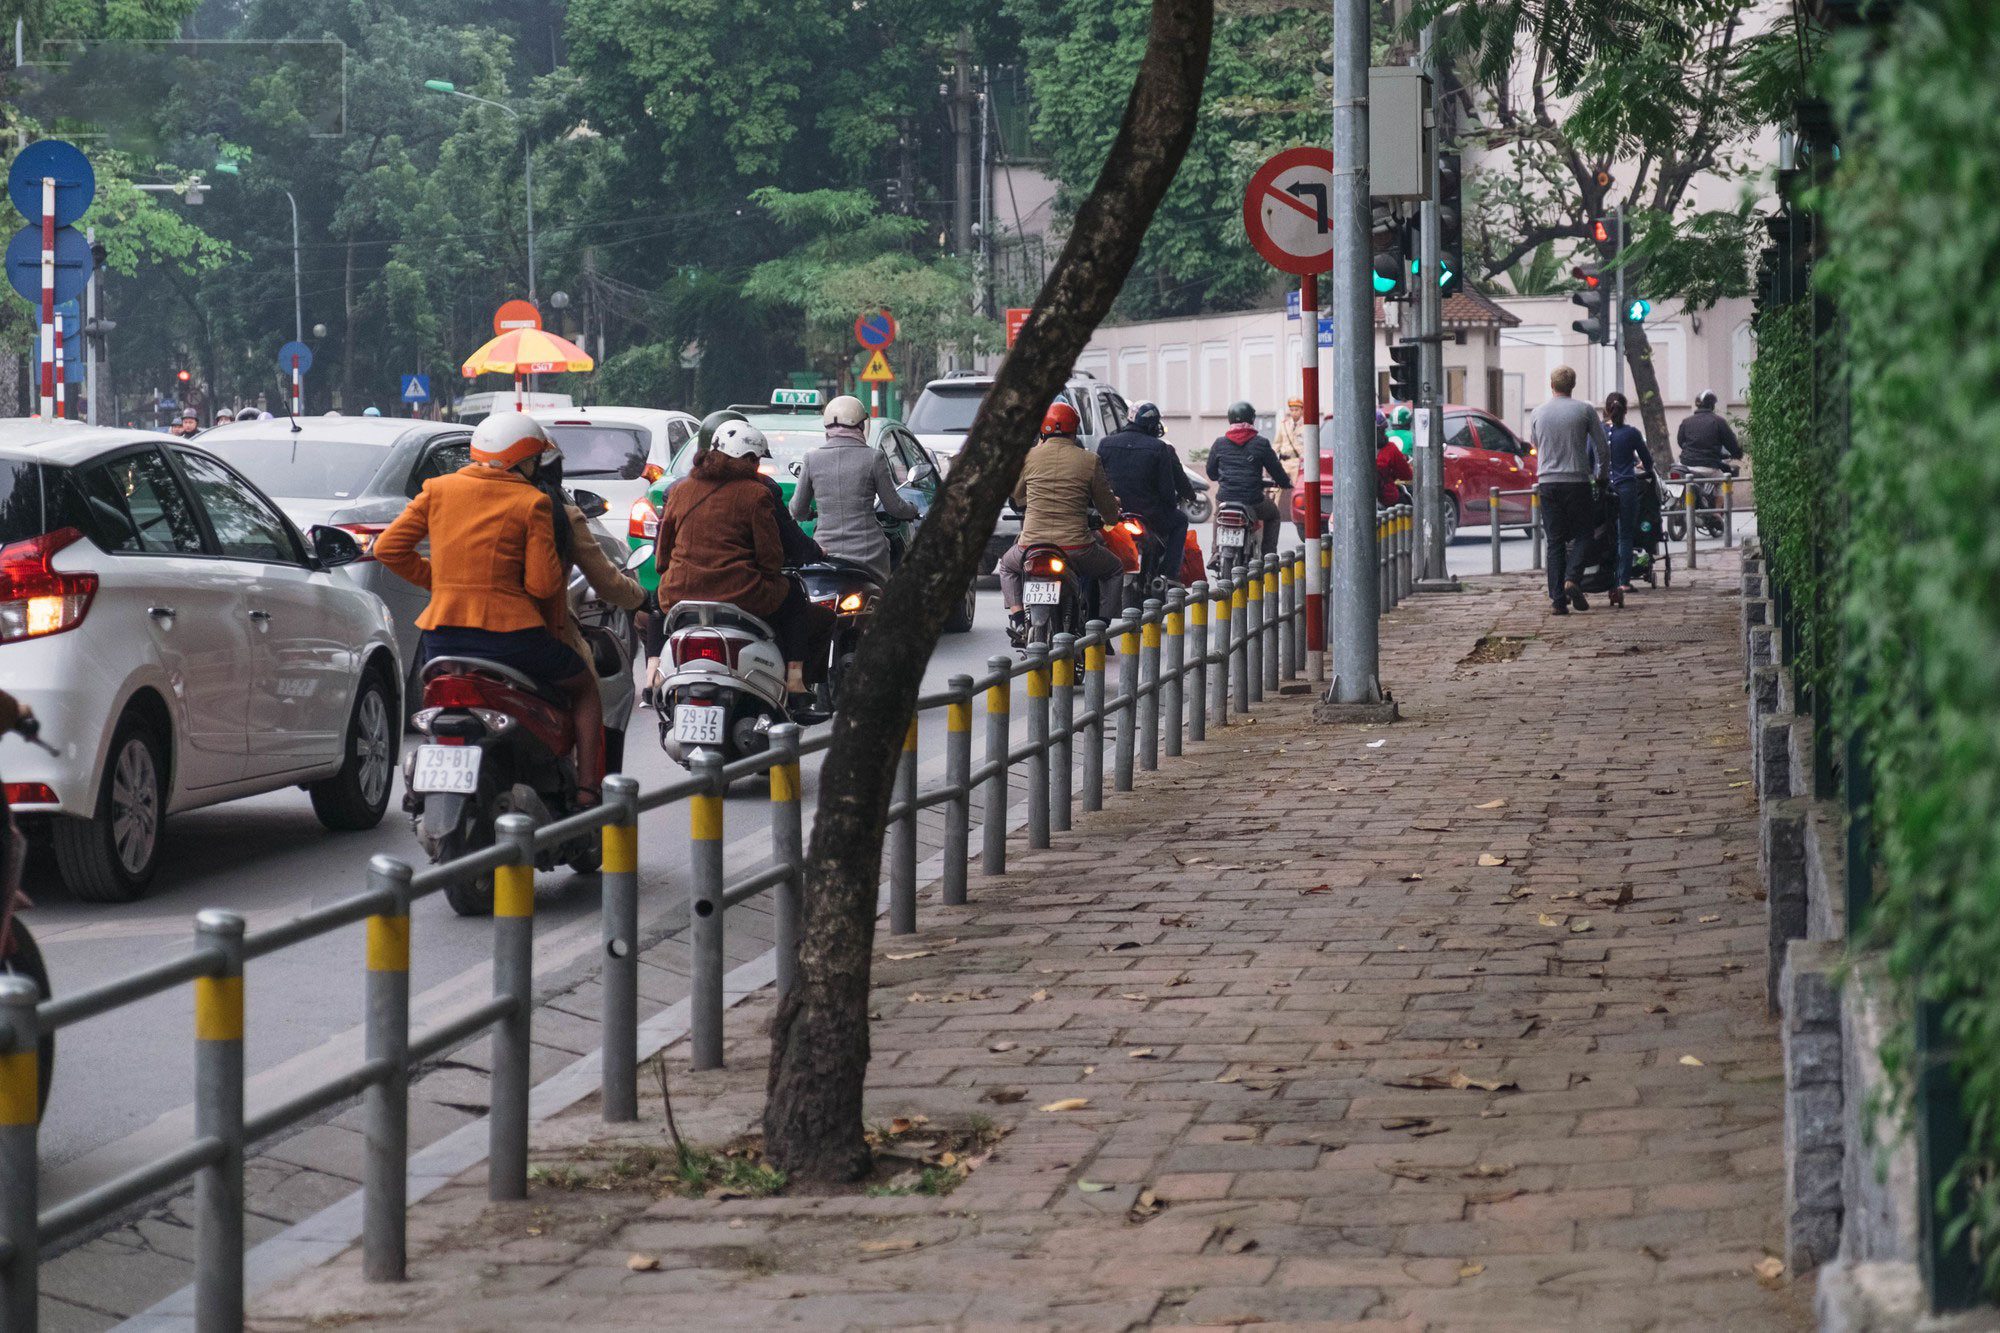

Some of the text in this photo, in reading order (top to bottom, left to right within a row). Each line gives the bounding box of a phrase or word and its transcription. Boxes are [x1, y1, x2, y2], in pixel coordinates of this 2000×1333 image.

[682, 708, 718, 725] 29-Y2
[680, 725, 717, 741] 7255
[426, 749, 471, 769] 29-B1
[420, 769, 474, 790] 123.29
